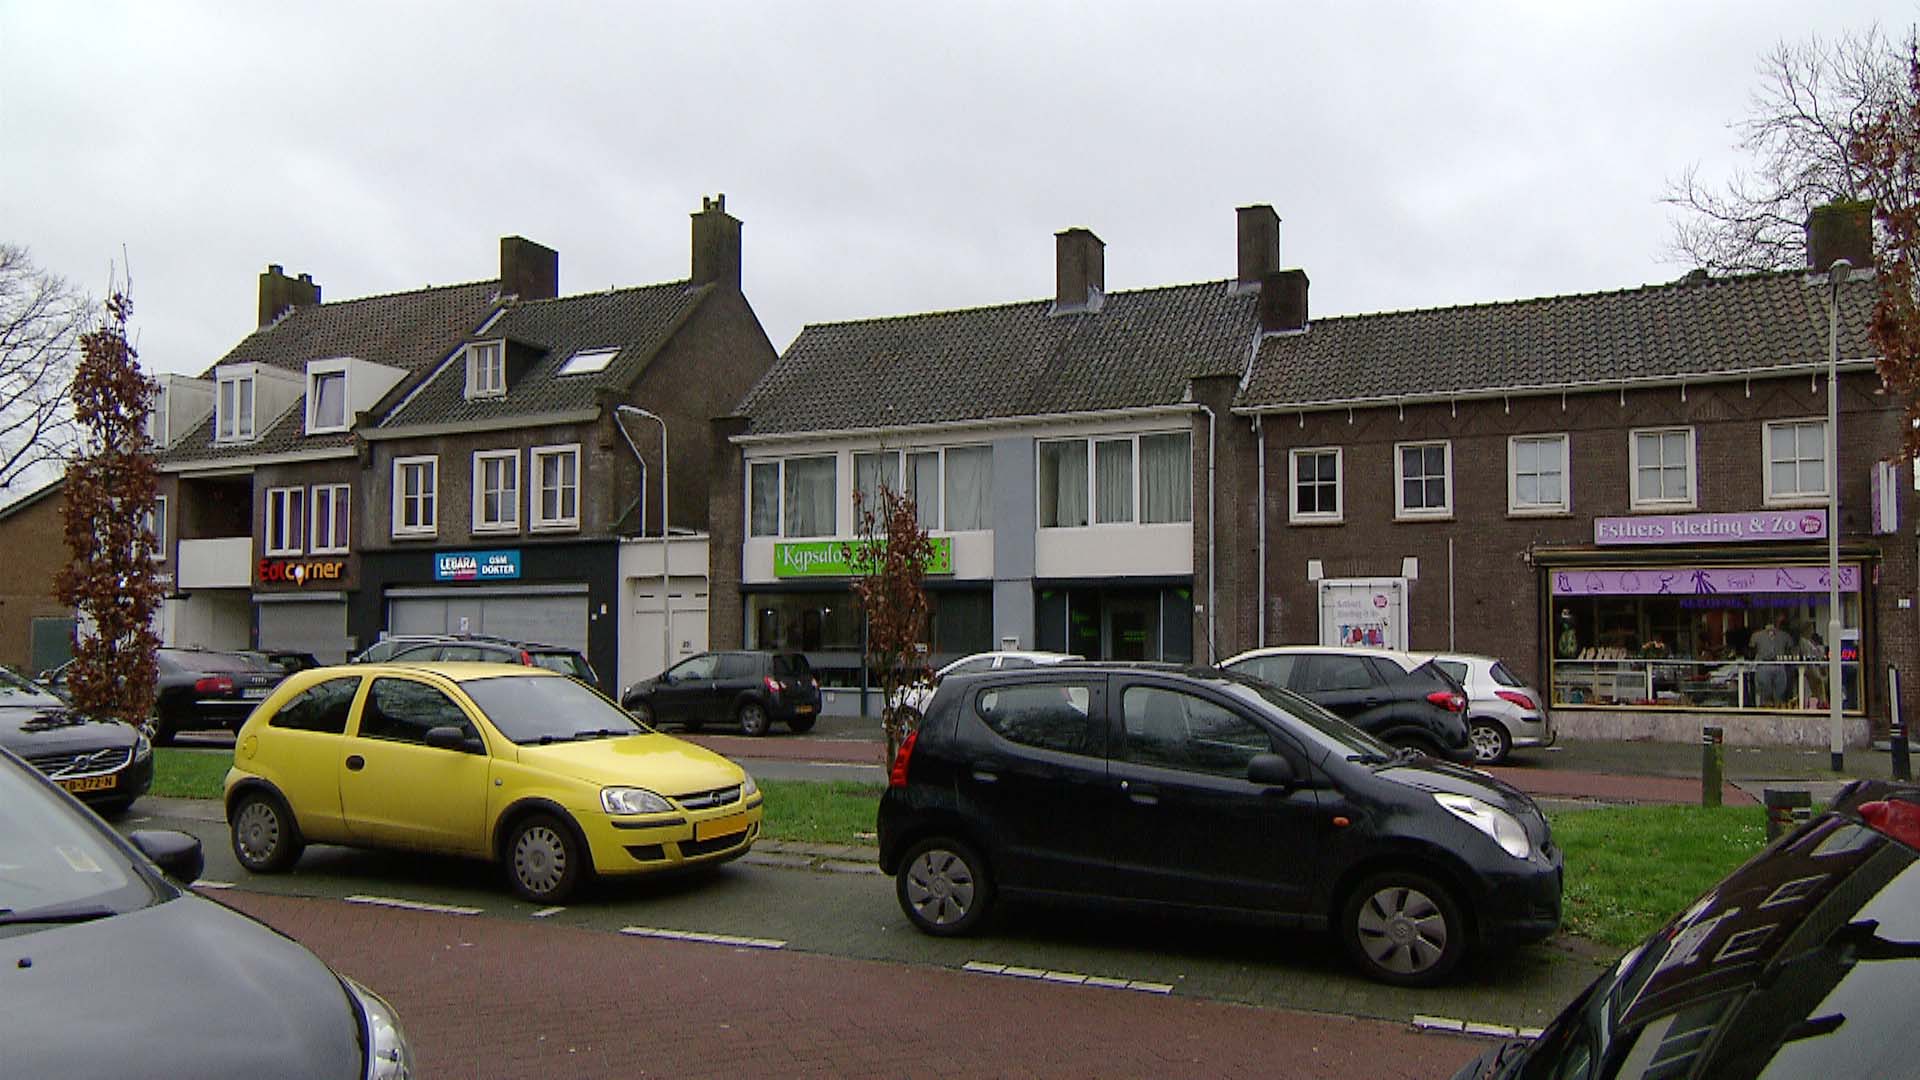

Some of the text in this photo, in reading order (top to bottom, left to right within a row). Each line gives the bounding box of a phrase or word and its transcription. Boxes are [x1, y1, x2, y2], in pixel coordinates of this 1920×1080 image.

[1599, 521, 1664, 537] Esthers
[1671, 519, 1743, 537] Kleding
[1749, 516, 1765, 532] &
[1771, 516, 1796, 532] Zo
[440, 557, 477, 570] LEBARA
